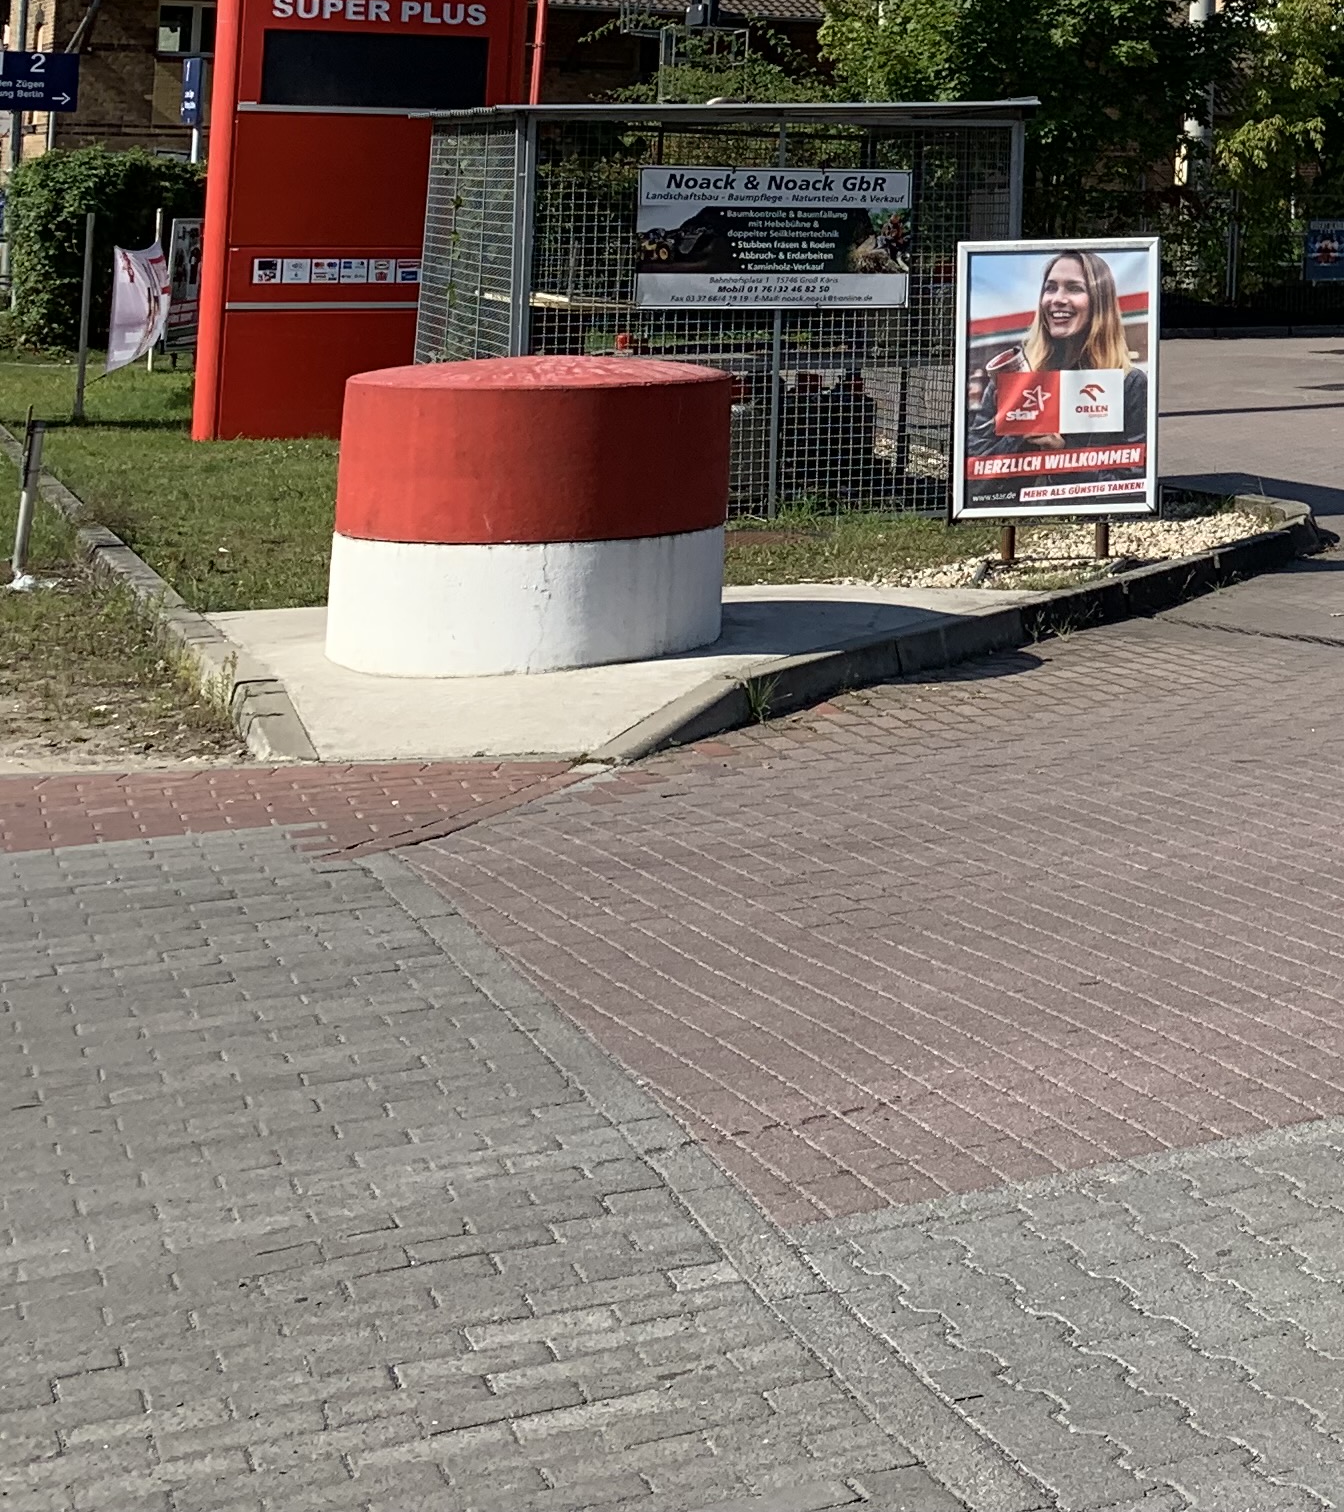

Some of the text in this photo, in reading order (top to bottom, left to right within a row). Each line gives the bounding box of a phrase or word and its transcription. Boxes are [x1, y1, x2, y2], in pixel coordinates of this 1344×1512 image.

[401, 1, 486, 25] PLUS
[30, 53, 46, 73] 2
[16, 79, 45, 89] Zügen
[17, 90, 44, 98] Berlin
[667, 173, 886, 192] Noack & Noack GbR
[646, 191, 719, 201] Landschaftsbau
[728, 193, 783, 204] Baumpflege
[792, 194, 839, 203] Naturstein
[841, 194, 857, 203] An-
[860, 195, 867, 203] &
[870, 194, 905, 203] Verkauf
[727, 210, 848, 221] Baumkontrolle & Baumfällung
[748, 220, 762, 228] mit
[764, 220, 812, 229] Hebebühne
[727, 229, 839, 239] doppelter Seilklettertechnik
[738, 240, 836, 249] Stubben fräsen & Roden
[739, 251, 834, 260] Abbruch- & Erdarbeiten
[747, 262, 825, 271] Kaminholz-Verkauf
[717, 285, 745, 293] Mobil
[1075, 405, 1108, 413] ORLEN
[1005, 408, 1039, 421] star
[974, 448, 1141, 475] HERZLICH WILLKOMMEN
[1023, 481, 1145, 499] MEHR ALS GÜNSTIG TANKEN!
[972, 491, 1017, 502] www.star.de
